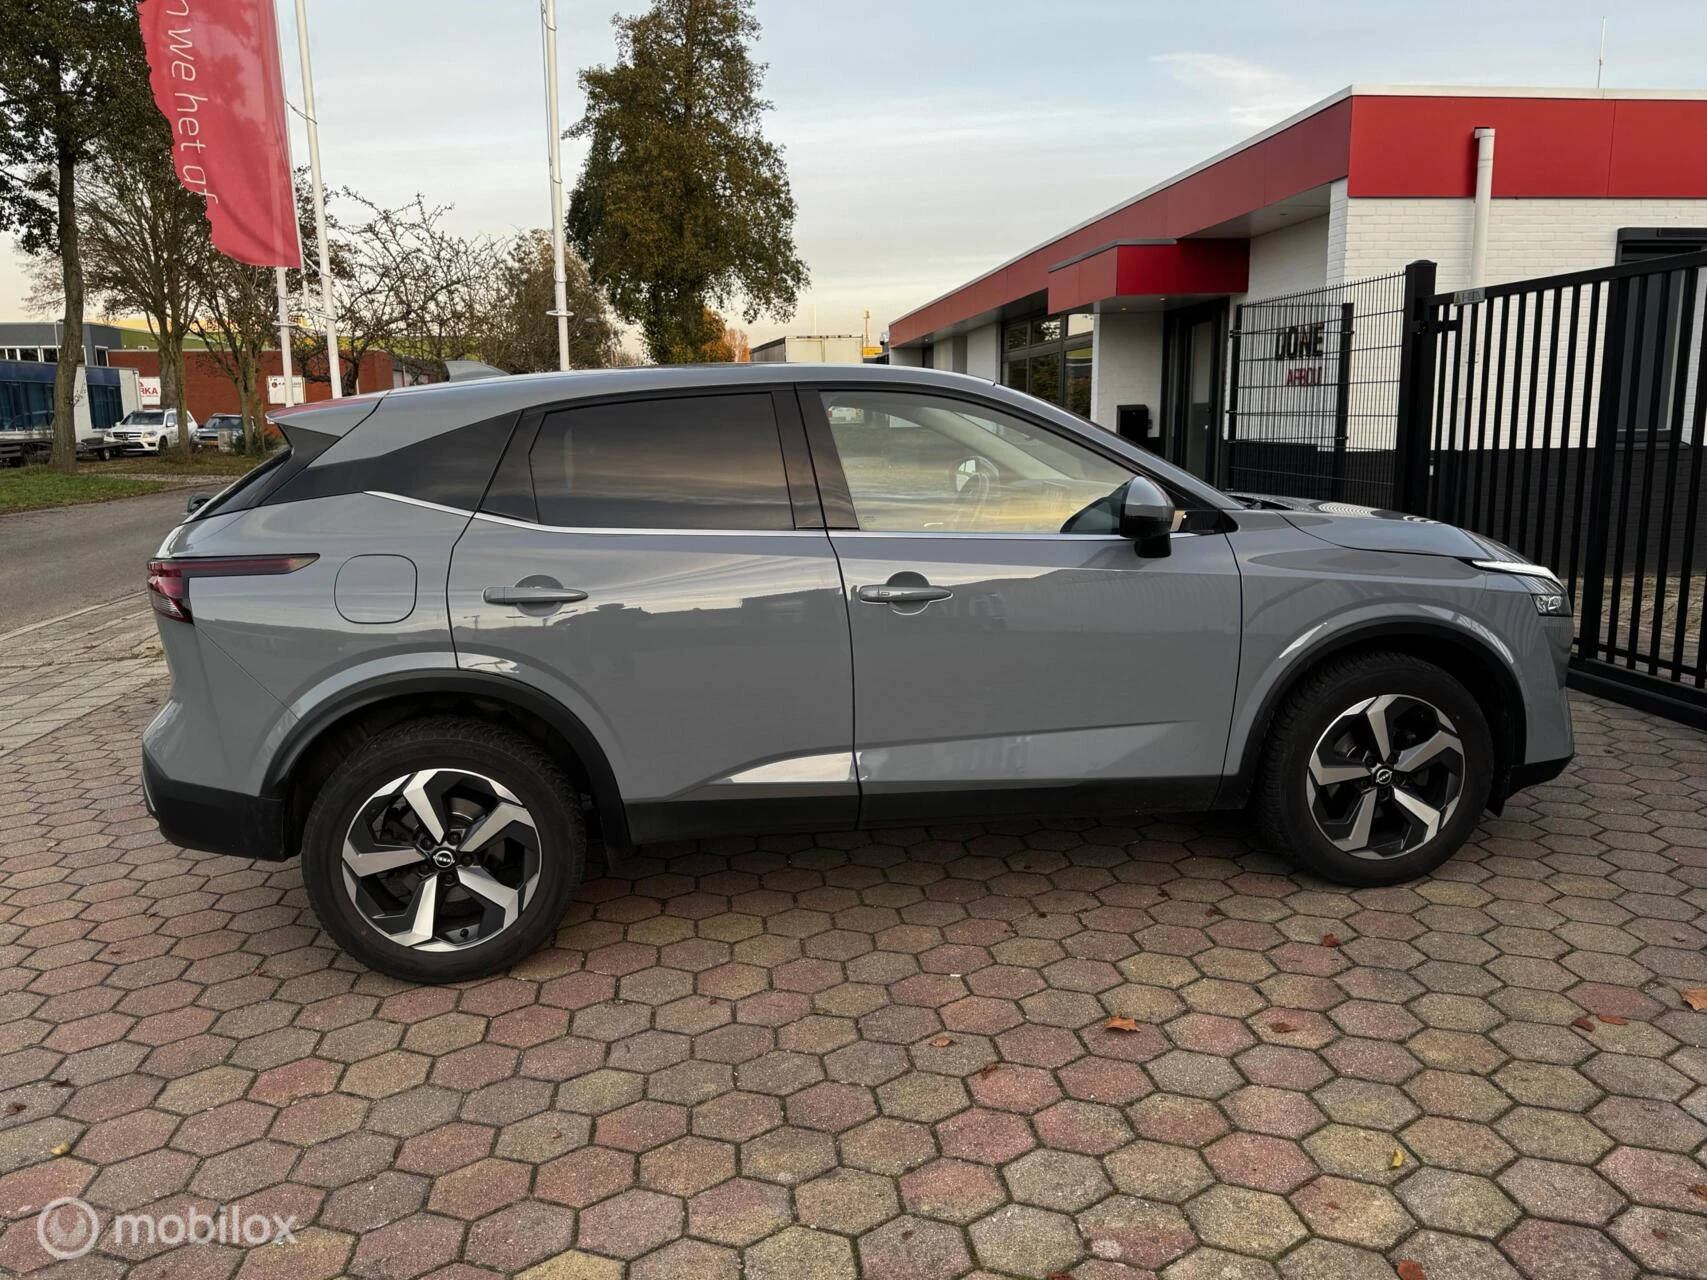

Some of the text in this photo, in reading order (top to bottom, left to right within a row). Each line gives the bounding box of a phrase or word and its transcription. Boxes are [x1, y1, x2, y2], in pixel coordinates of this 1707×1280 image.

[168, 28, 196, 81] we
[174, 92, 209, 154] het
[183, 165, 218, 204] af
